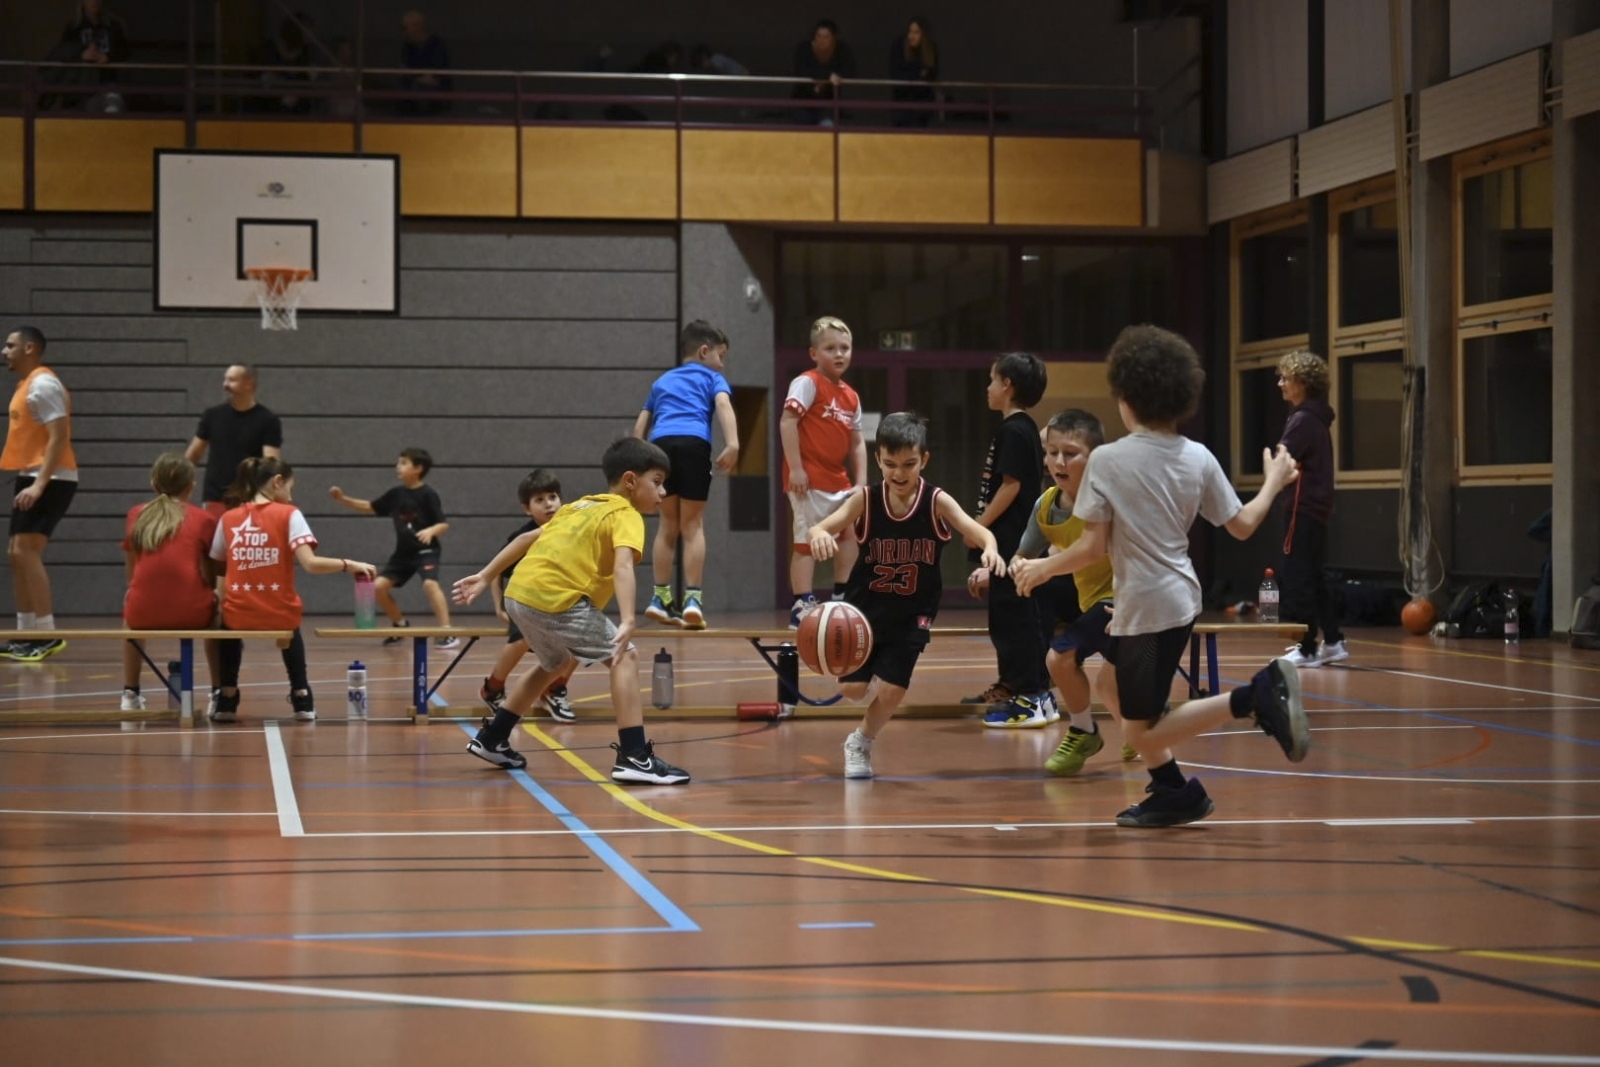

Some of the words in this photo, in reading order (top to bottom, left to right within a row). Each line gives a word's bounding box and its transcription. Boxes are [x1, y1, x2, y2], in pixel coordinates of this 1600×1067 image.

[244, 533, 268, 546] TOP
[232, 547, 279, 561] SCORER
[869, 563, 919, 596] 23
